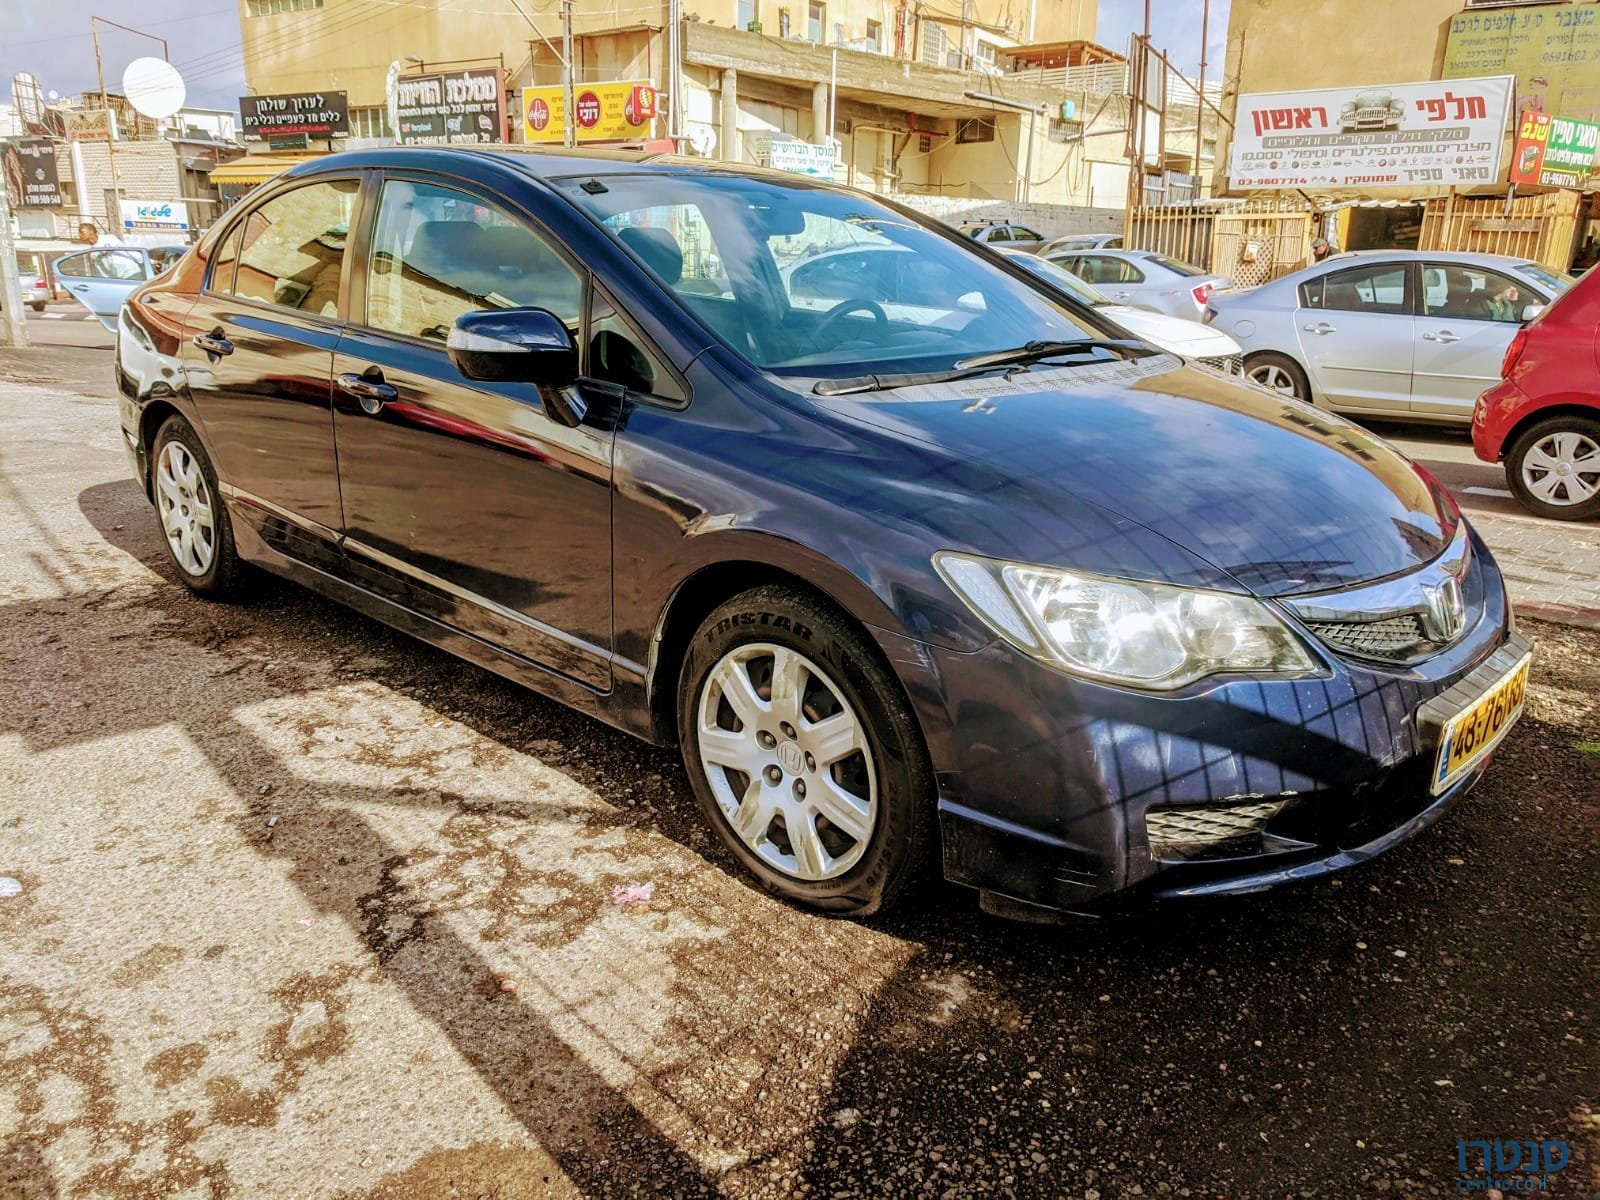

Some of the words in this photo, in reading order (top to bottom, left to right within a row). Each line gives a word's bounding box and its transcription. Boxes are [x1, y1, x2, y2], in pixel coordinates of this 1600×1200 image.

[256, 96, 287, 115] שולחן
[291, 93, 324, 113] לערוך
[1415, 91, 1487, 121] חלפי
[245, 116, 260, 126] בית
[260, 113, 275, 125] וכלי
[276, 113, 305, 124] פעמיים
[306, 113, 318, 122] חד
[320, 110, 340, 122] כלים
[1251, 106, 1329, 137] ראשון
[1329, 133, 1375, 145] מקוריים
[1384, 131, 1421, 144] חילוף
[1431, 128, 1463, 141] חלקי
[1575, 123, 1598, 149] סאני
[1268, 136, 1320, 147] וחילופיים
[771, 142, 808, 155] הברושים
[812, 146, 834, 158] מוסך
[1288, 149, 1328, 159] וטיפולי
[1452, 166, 1490, 180] סאני
[1238, 177, 1307, 186] 03-9607714
[1329, 176, 1338, 184] 4
[1344, 174, 1398, 185] שמוטקין
[704, 612, 813, 643] TRISTAR
